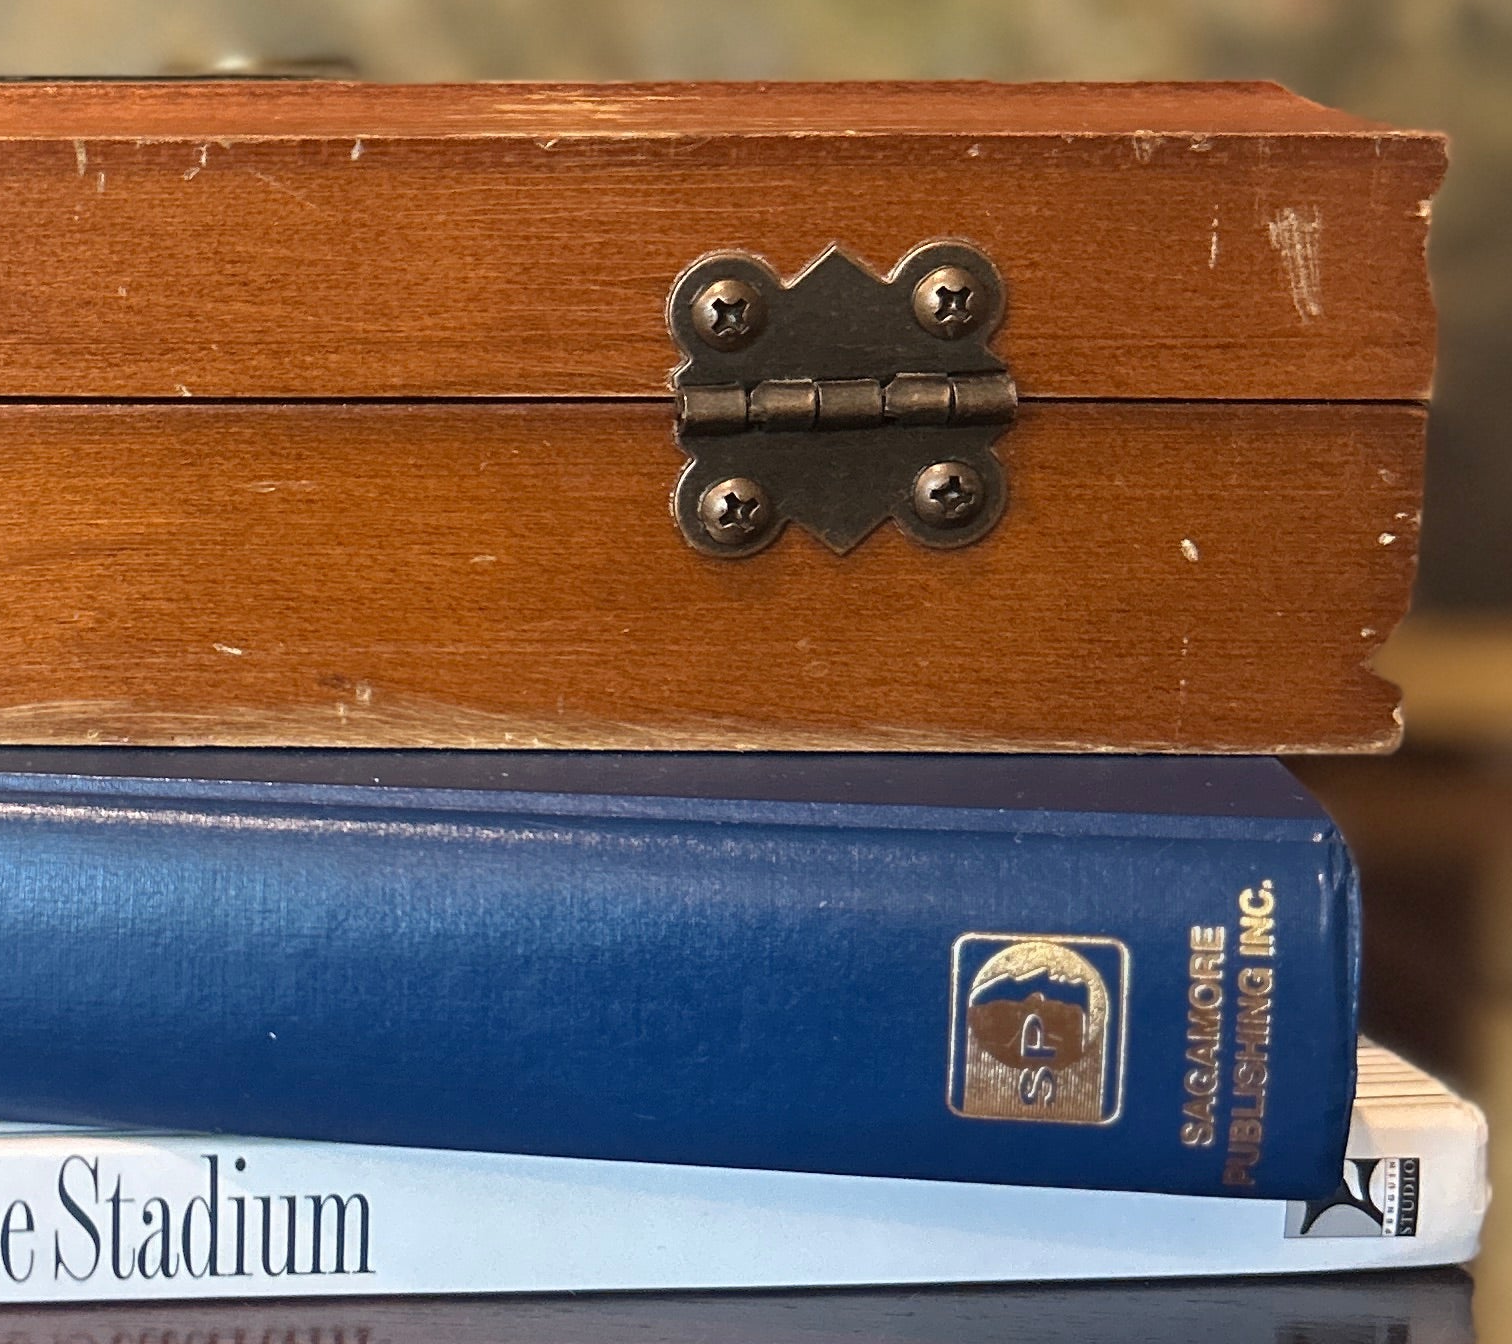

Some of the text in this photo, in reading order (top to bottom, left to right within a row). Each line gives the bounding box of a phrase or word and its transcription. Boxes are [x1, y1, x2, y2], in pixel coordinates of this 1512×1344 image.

[1181, 925, 1226, 1147] SAGAMORE
[1223, 878, 1277, 1187] PUBLISHING INC.
[54, 1154, 376, 1281] Stadium
[1400, 1158, 1417, 1236] STUDIO
